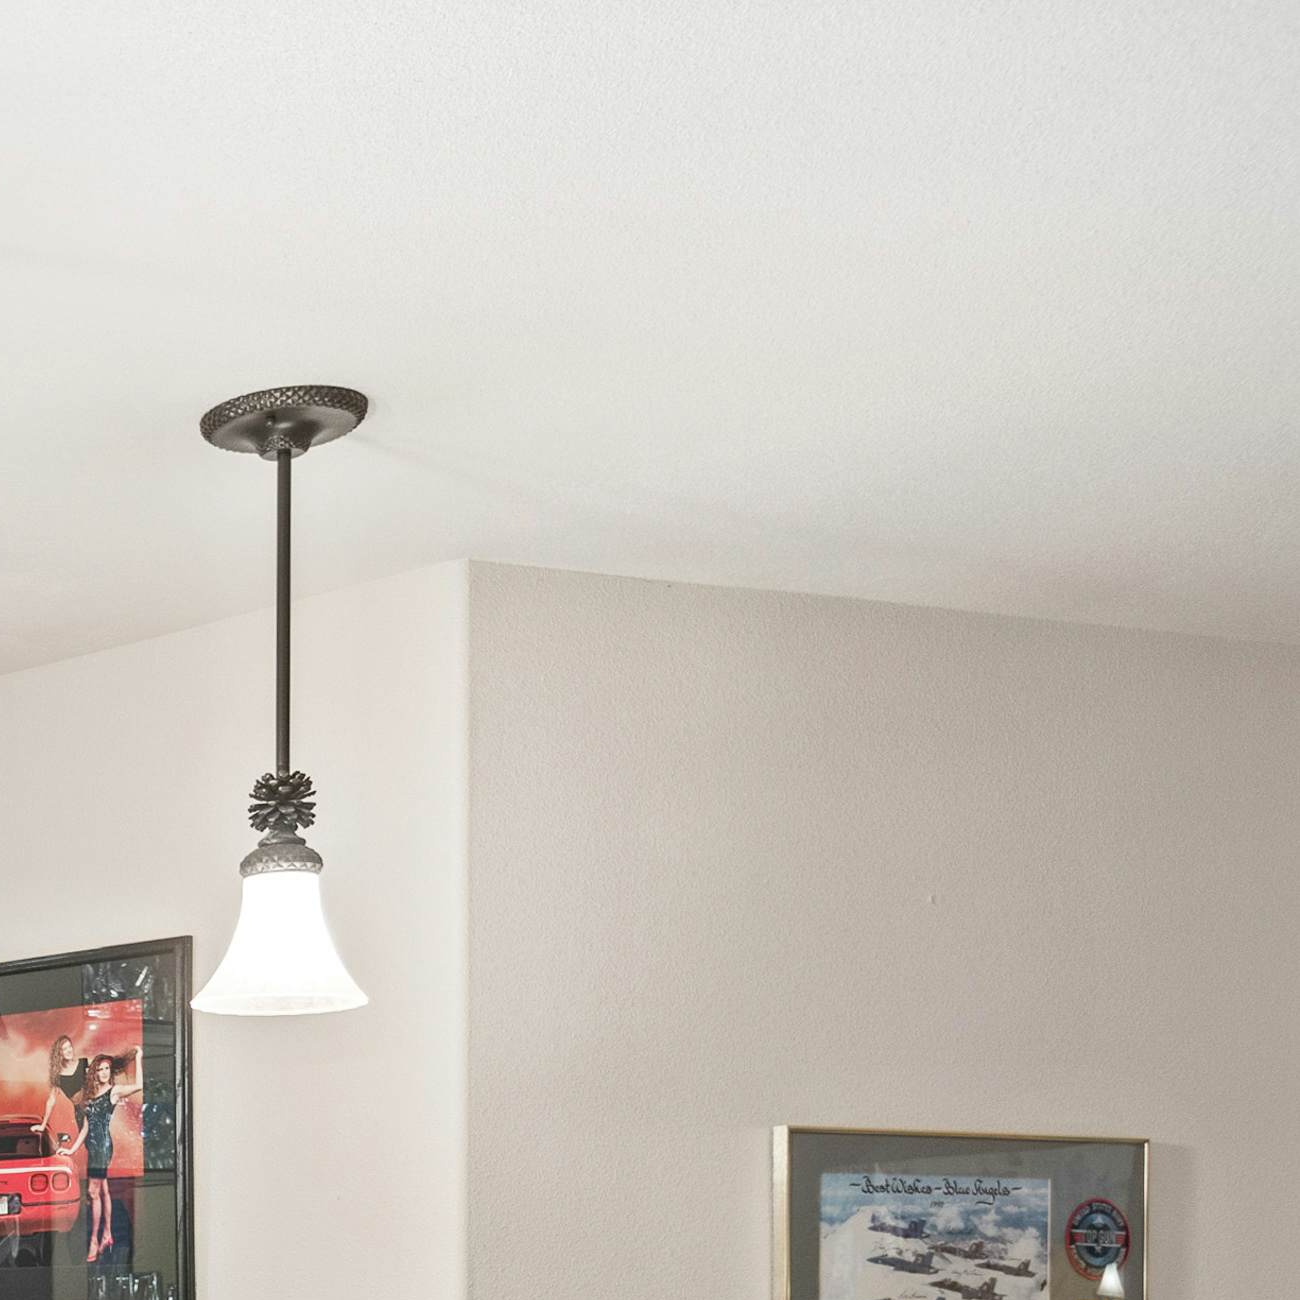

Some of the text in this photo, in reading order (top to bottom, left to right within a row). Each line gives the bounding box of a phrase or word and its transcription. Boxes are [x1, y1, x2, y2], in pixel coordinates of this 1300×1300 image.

[862, 1176, 1010, 1203] Best Wishes Blue Angels
